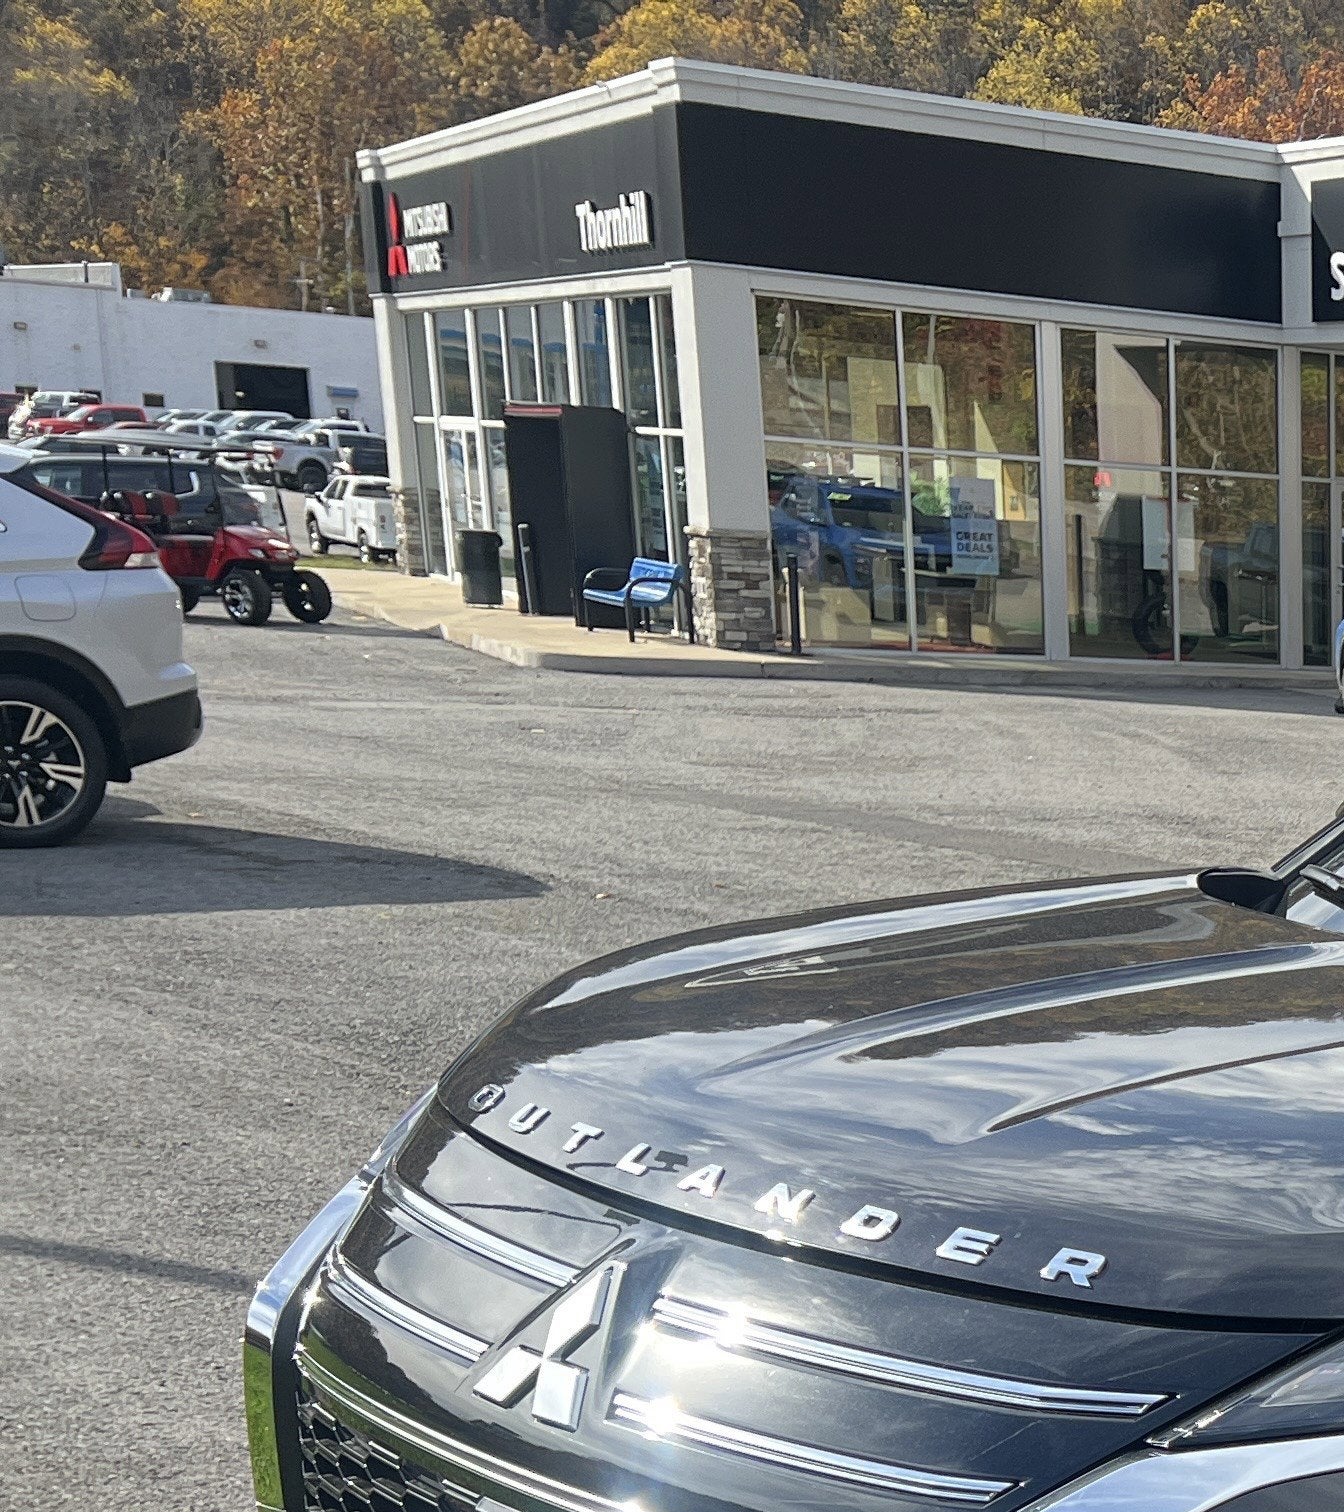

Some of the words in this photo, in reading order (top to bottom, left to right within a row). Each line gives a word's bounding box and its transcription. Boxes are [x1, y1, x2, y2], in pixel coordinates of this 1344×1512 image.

[575, 190, 649, 253] Thornhill
[405, 241, 442, 274] MOTORS
[957, 542, 995, 553] DEALS
[467, 1083, 1109, 1289] OUTLANDER
